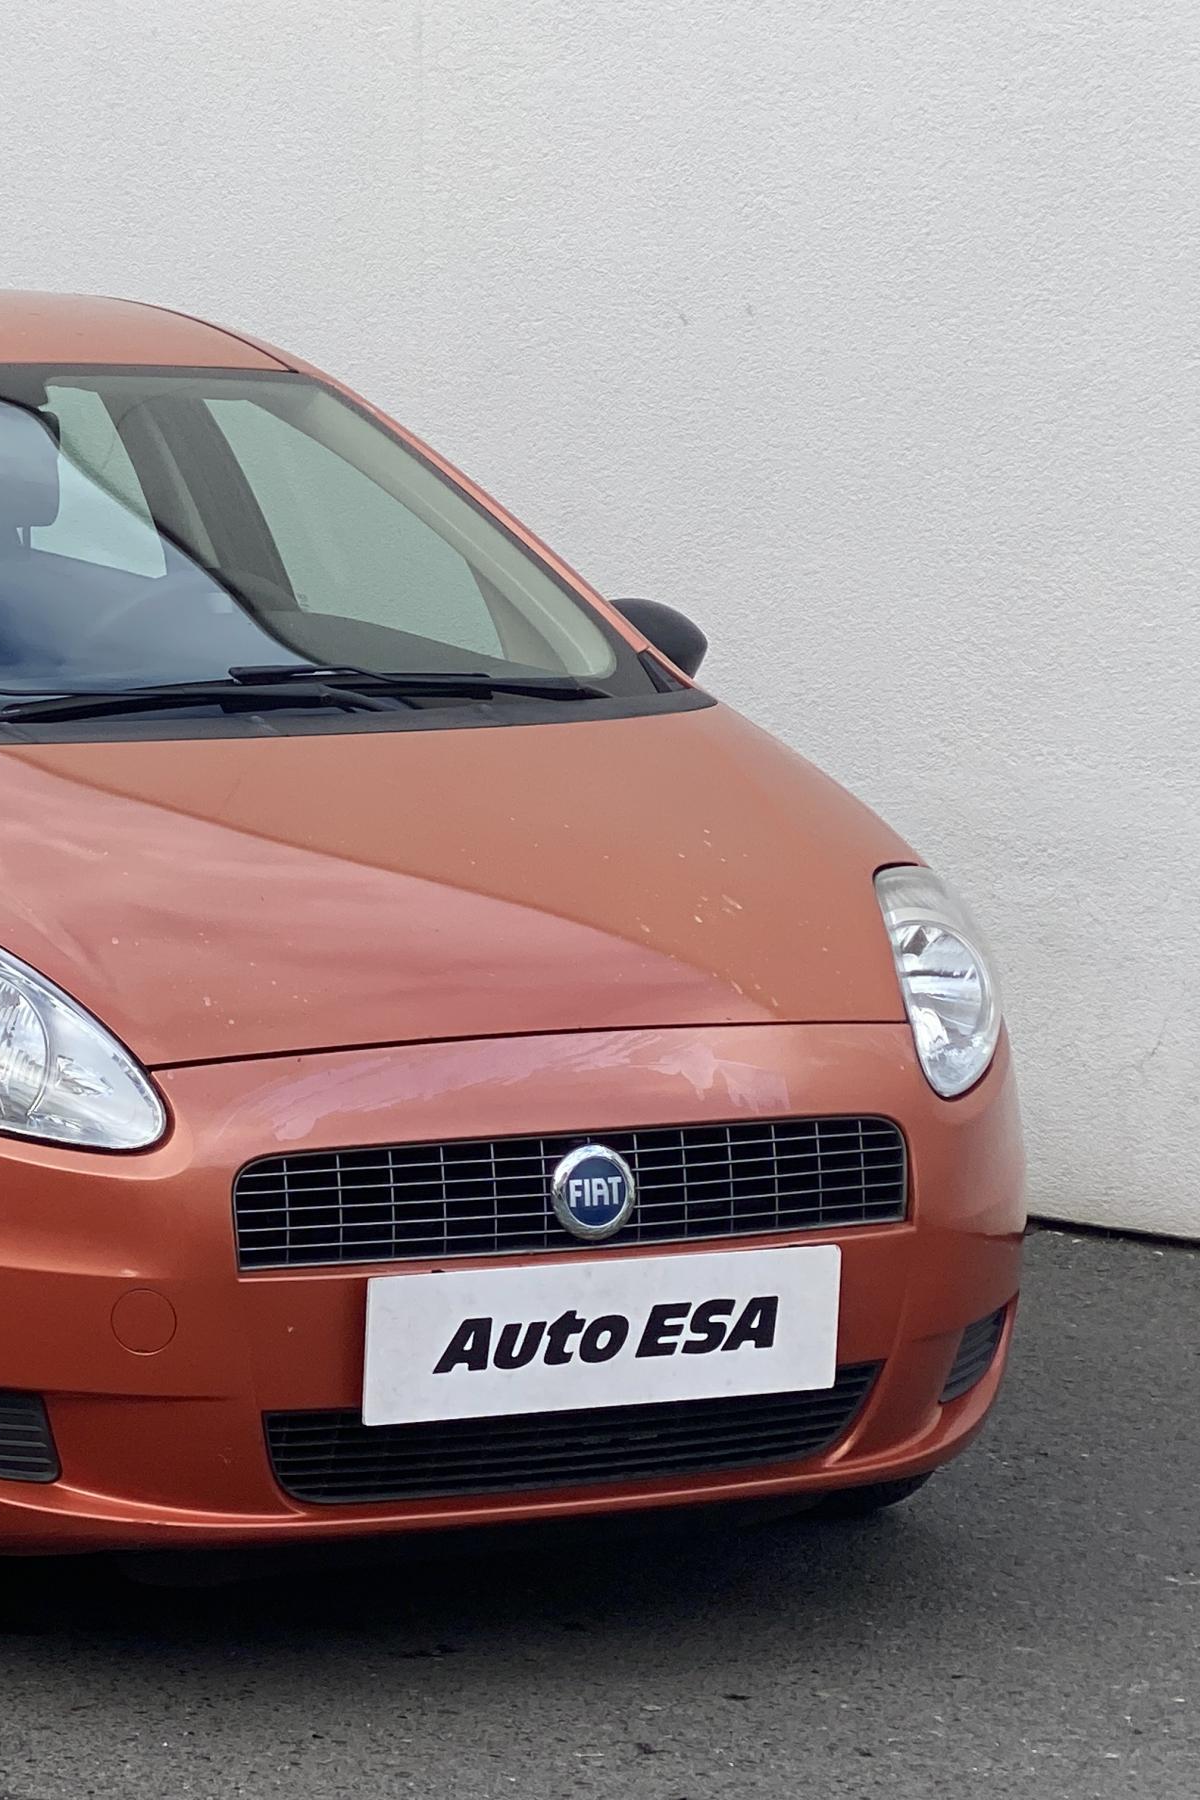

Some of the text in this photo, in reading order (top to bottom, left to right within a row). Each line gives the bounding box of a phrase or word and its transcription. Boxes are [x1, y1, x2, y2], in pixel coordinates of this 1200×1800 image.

[568, 1176, 622, 1208] FIAT
[432, 1295, 779, 1374] Auto ESA
